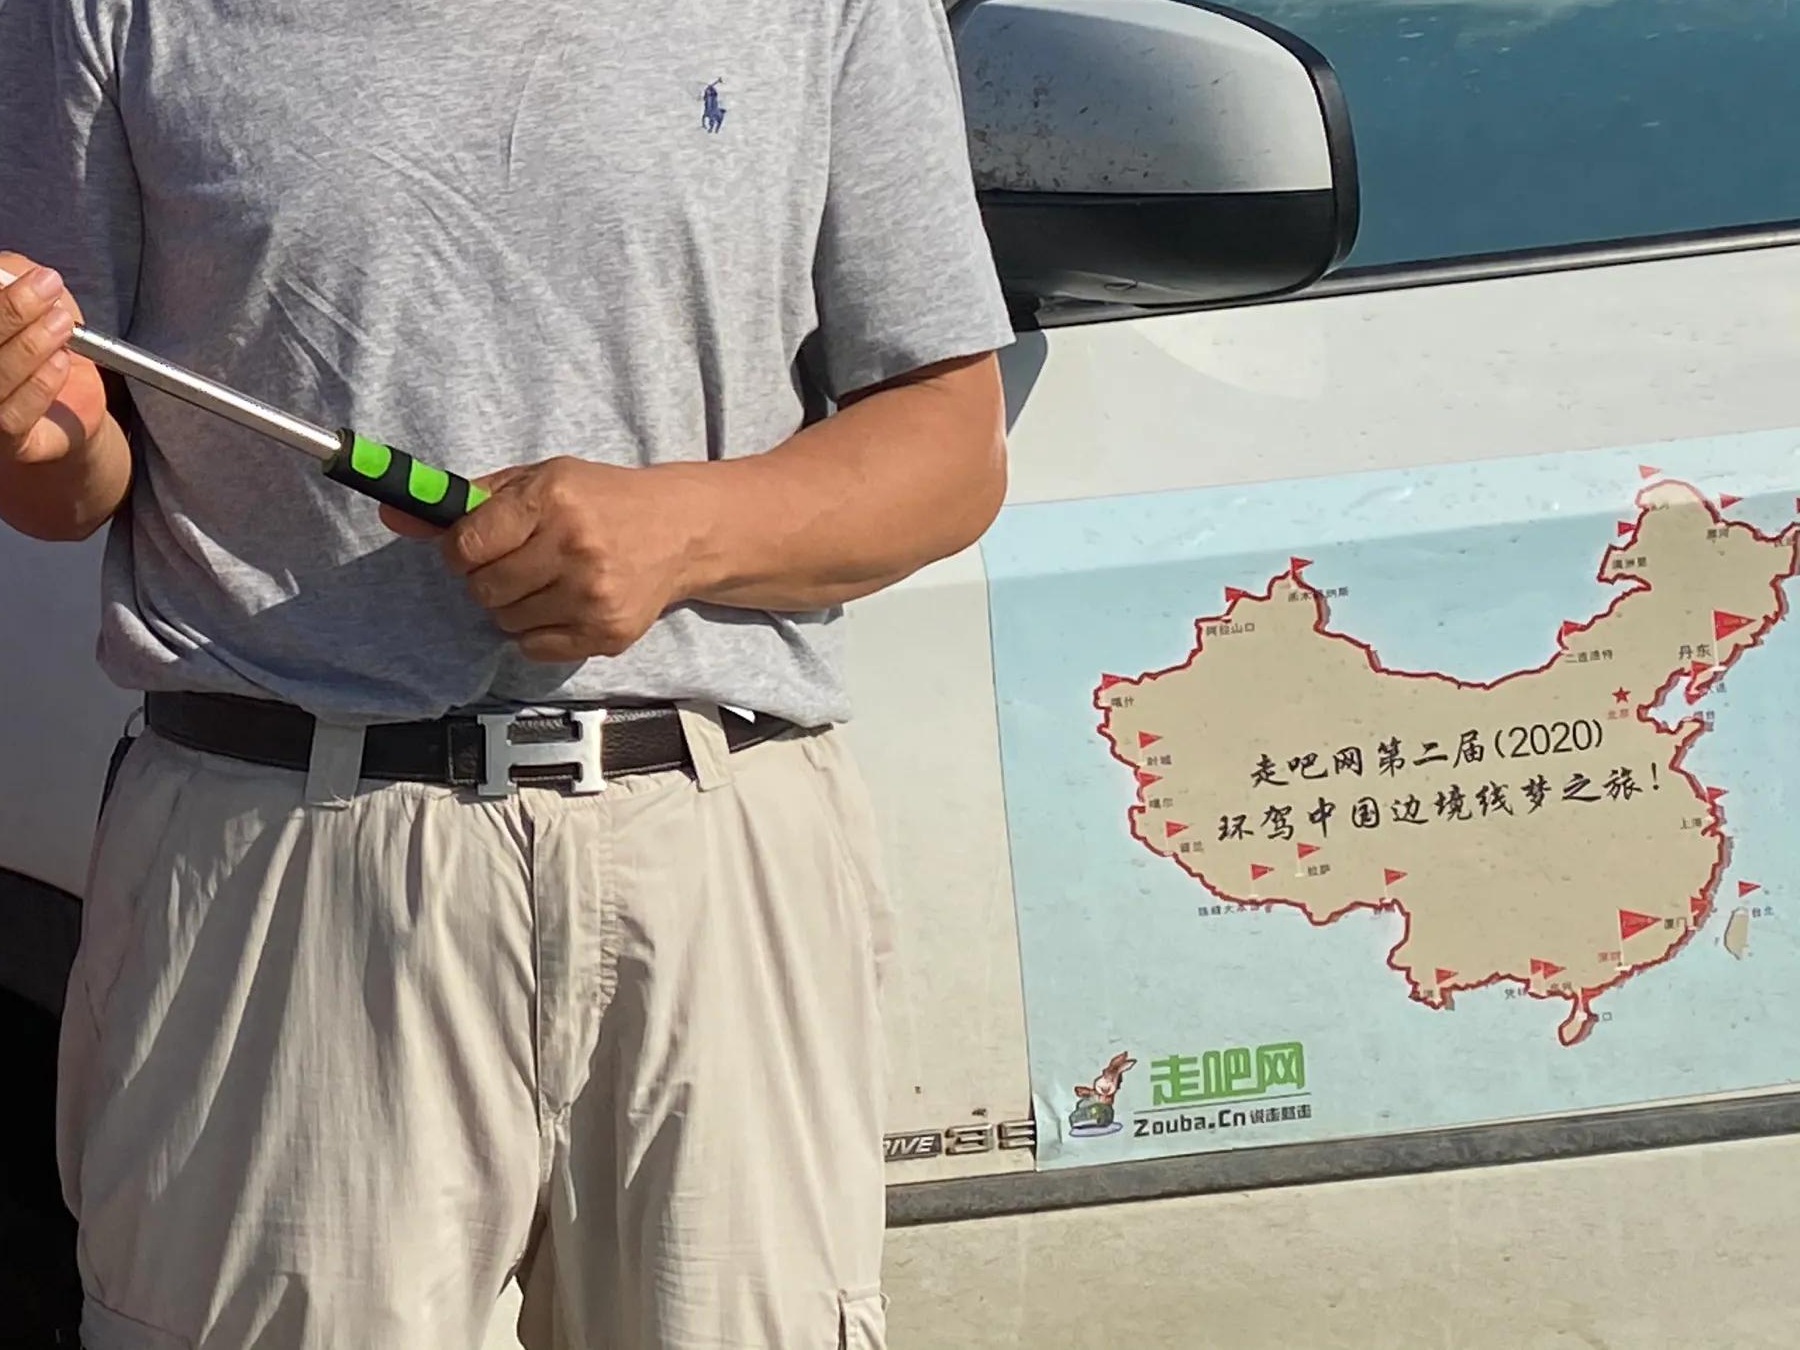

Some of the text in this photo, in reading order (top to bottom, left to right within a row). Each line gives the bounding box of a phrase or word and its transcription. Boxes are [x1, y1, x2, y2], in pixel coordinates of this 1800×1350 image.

[1678, 643, 1712, 660] 丹东
[1250, 719, 1602, 789] 走吧网第二届(2020)
[1150, 1042, 1305, 1106] 走吧网
[1133, 1109, 1246, 1138] Zouba.Cn
